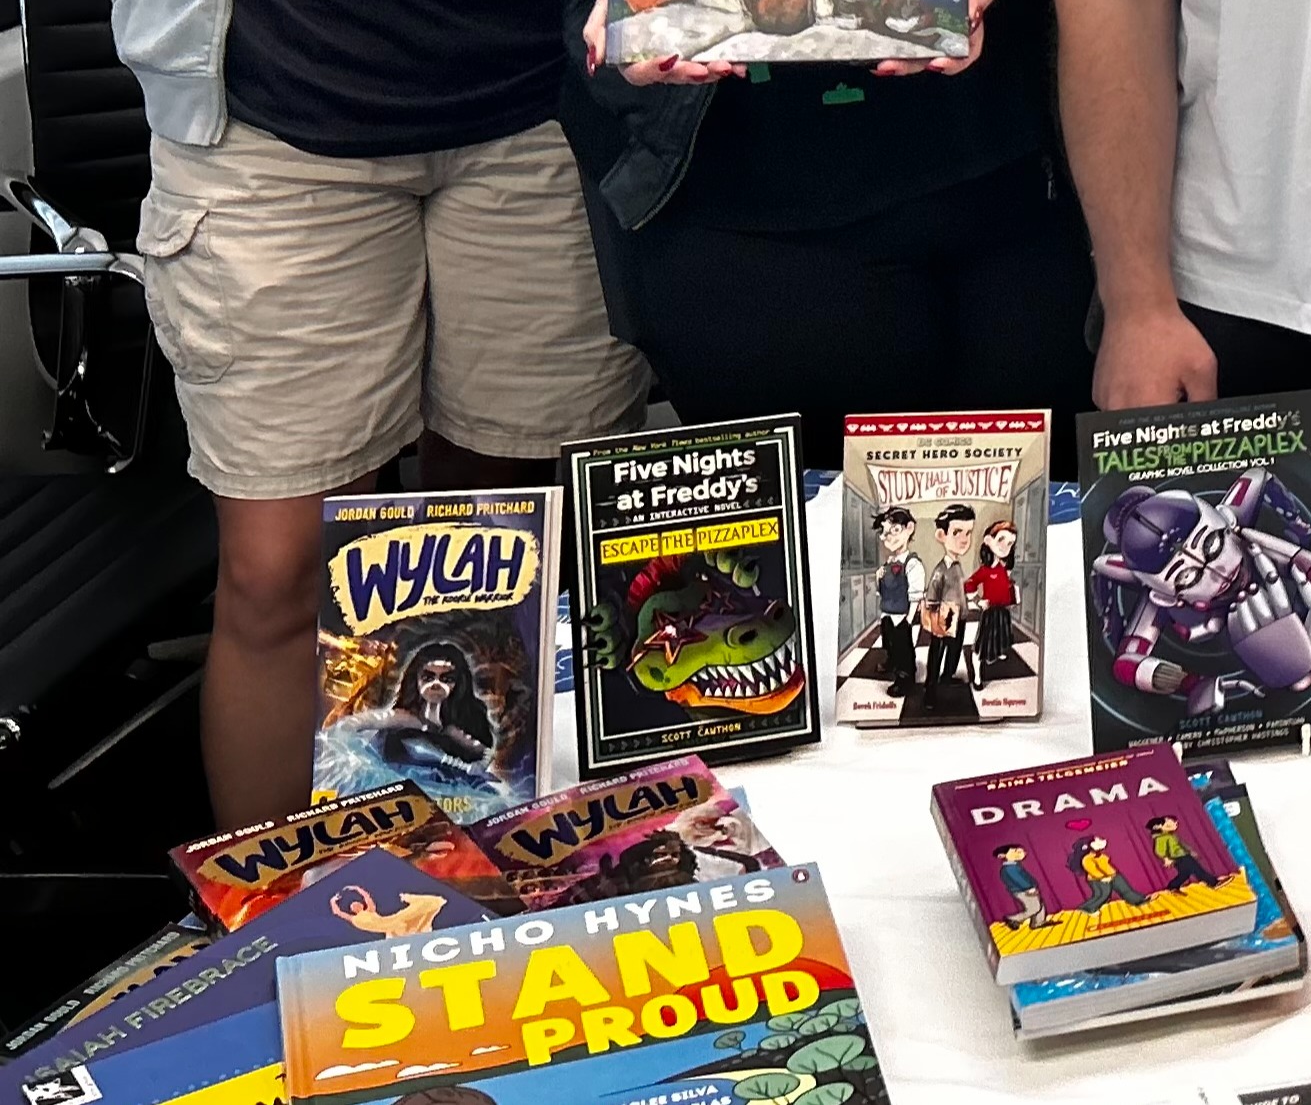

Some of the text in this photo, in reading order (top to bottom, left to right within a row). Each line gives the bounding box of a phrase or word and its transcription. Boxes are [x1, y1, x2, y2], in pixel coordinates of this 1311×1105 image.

[1092, 431, 1133, 450] Five
[1136, 422, 1198, 445] Nights
[1200, 421, 1220, 437] at
[1222, 410, 1302, 434] Freddy's
[613, 447, 757, 483] Five Nights
[866, 447, 1024, 461] SECRET HERO SOCIETY
[616, 475, 759, 511] at Freddy's
[877, 464, 1012, 505] STUDY HALL OF JUSTICE
[335, 500, 536, 522] JORDAN GOULD RICHARD PRITCHARD
[602, 520, 779, 559] ESCAPE THE PIZZAPLEX
[345, 532, 527, 623] WYLAH
[986, 776, 1034, 792] RAINA
[1038, 759, 1130, 783] TELGEMEIER
[510, 776, 700, 862] WYLAH
[970, 776, 1171, 827] DRAMA
[215, 799, 416, 885] WYLAH
[342, 877, 777, 980] NICHO HYNES
[124, 935, 280, 1032] FIREBRACE
[334, 908, 806, 1050] STAND
[519, 969, 822, 1068] PROUD
